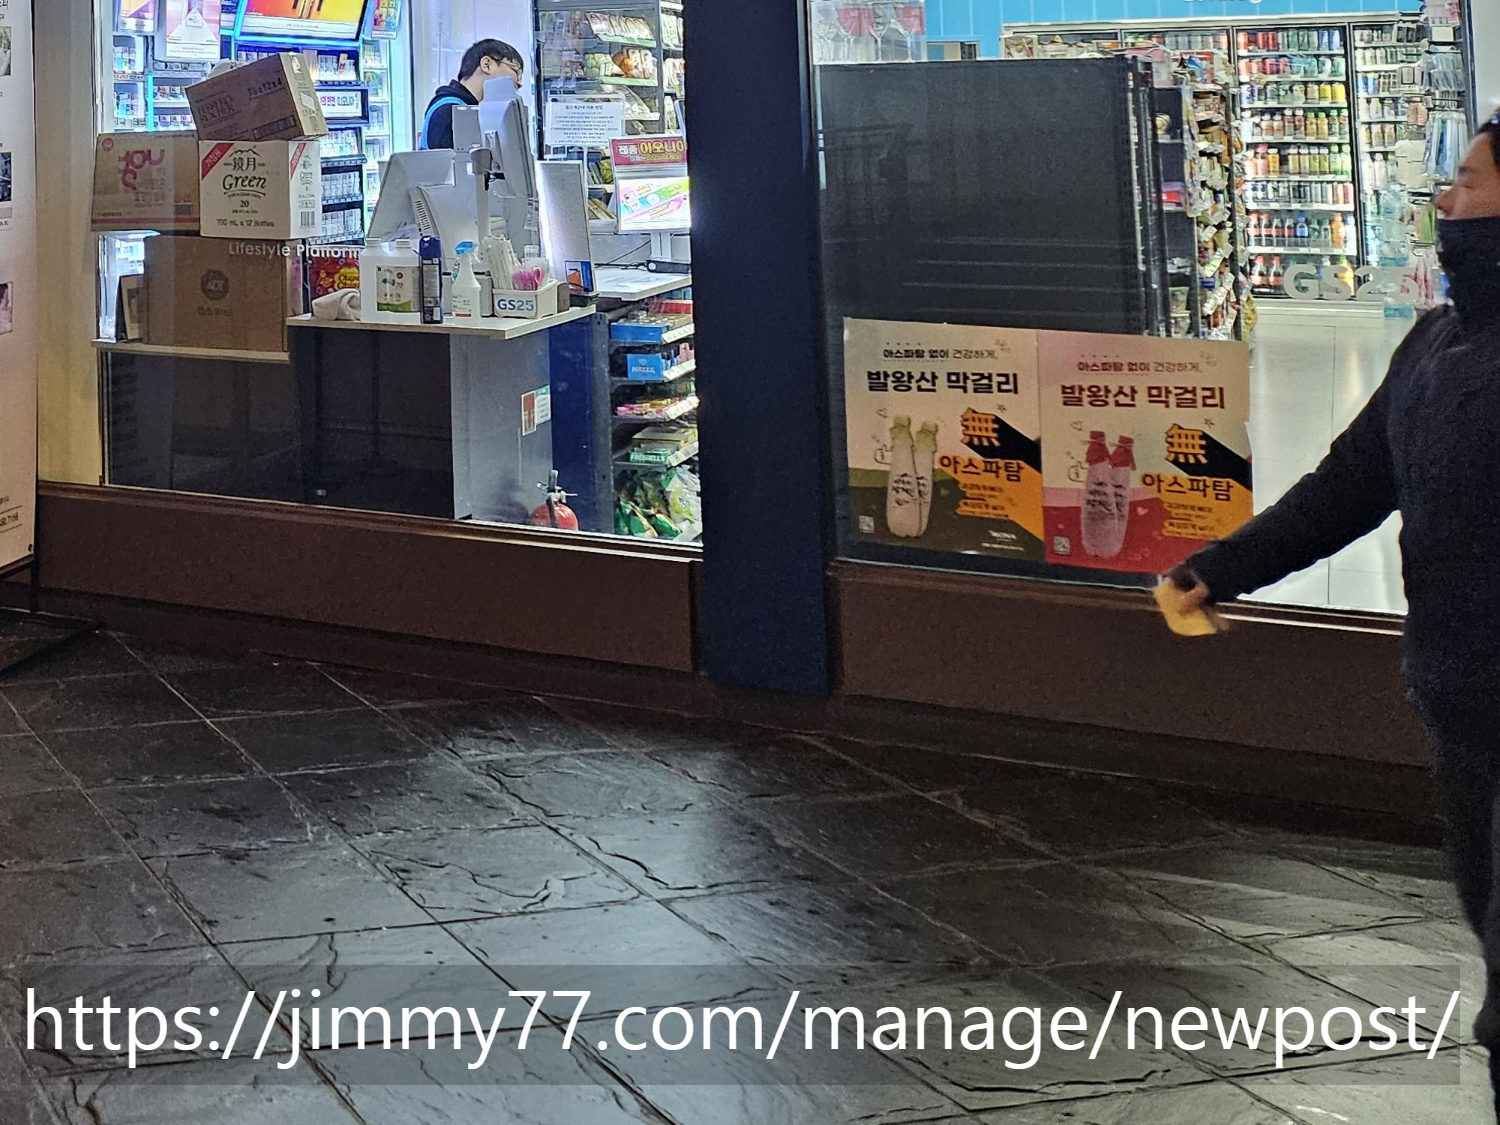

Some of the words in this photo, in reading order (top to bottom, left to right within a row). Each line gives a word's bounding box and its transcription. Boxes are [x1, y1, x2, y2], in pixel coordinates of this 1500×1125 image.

[222, 173, 267, 191] Green
[240, 200, 250, 208] 20
[216, 218, 228, 226] 700
[245, 219, 252, 227] 12
[253, 219, 275, 227] Bottles
[229, 241, 291, 259] Lifestyle
[1283, 263, 1420, 303] GS25
[497, 298, 534, 312] GS25
[928, 348, 950, 359] 없이
[1127, 361, 1150, 372] 없이
[866, 370, 938, 393] 발왕산
[946, 371, 1019, 395] 막걸리
[1061, 384, 1138, 408] 발왕산
[1146, 385, 1225, 409] 막걸리
[960, 406, 1000, 448] 無
[1165, 423, 1208, 464] 無
[939, 454, 1024, 483] 아스파탐
[1141, 473, 1234, 502] 아스파탐
